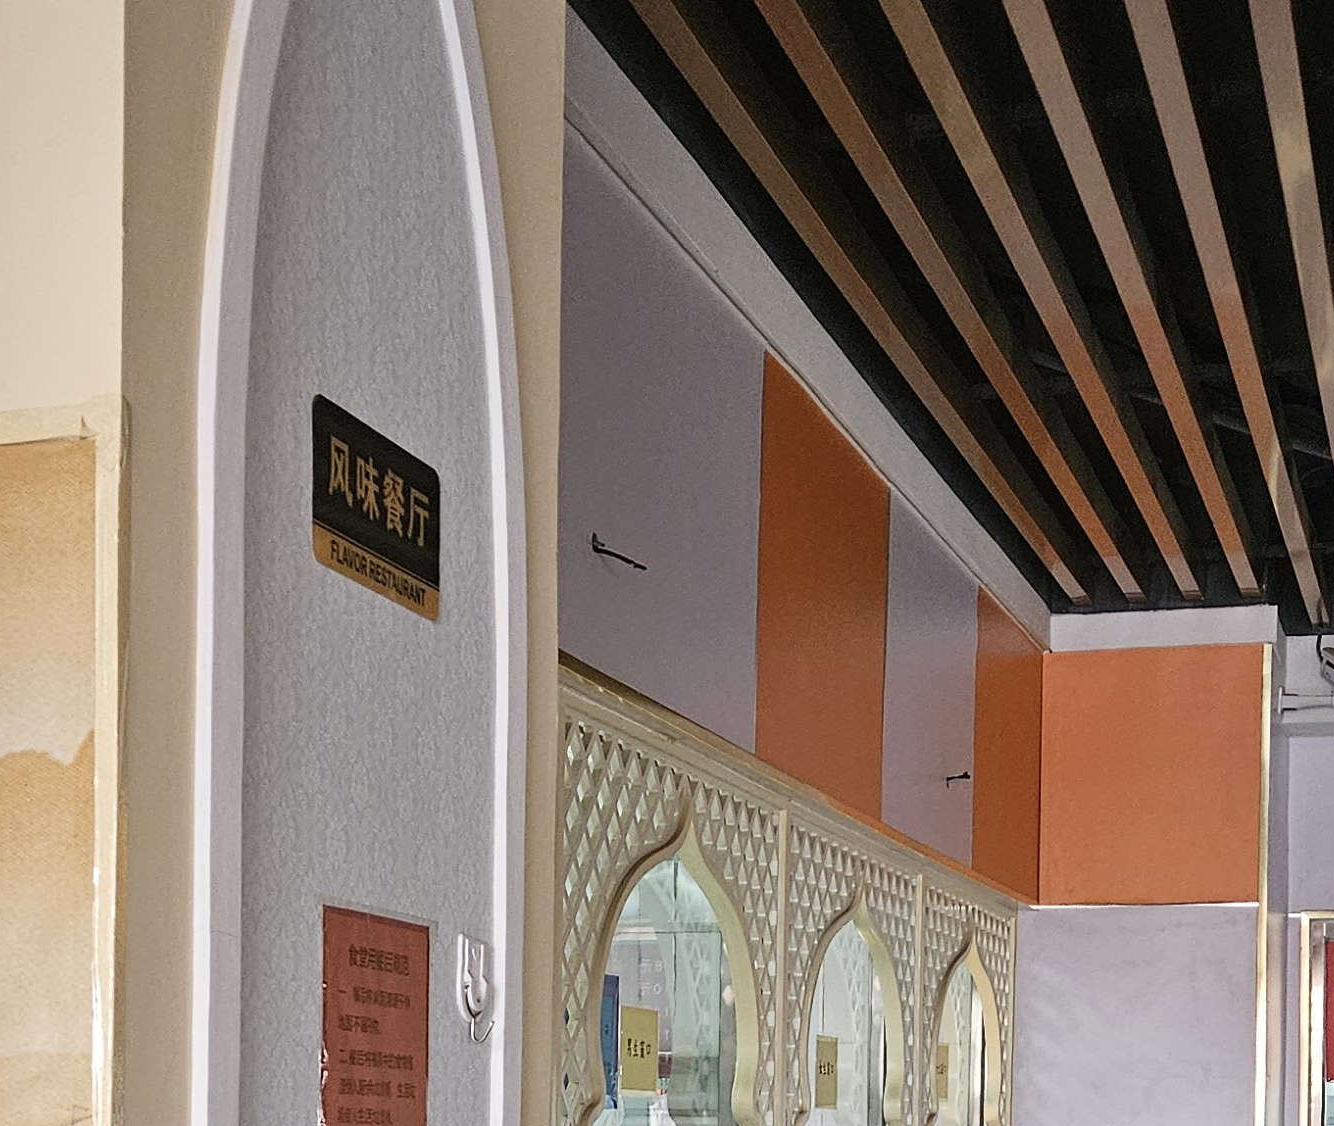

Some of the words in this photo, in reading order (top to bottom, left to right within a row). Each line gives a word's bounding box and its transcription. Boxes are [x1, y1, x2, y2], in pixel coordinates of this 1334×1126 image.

[329, 435, 430, 547] 风味餐厅
[330, 539, 368, 578] FLAVOR
[367, 557, 427, 608] RESTAURANT
[627, 1037, 652, 1059] 男生窗口
